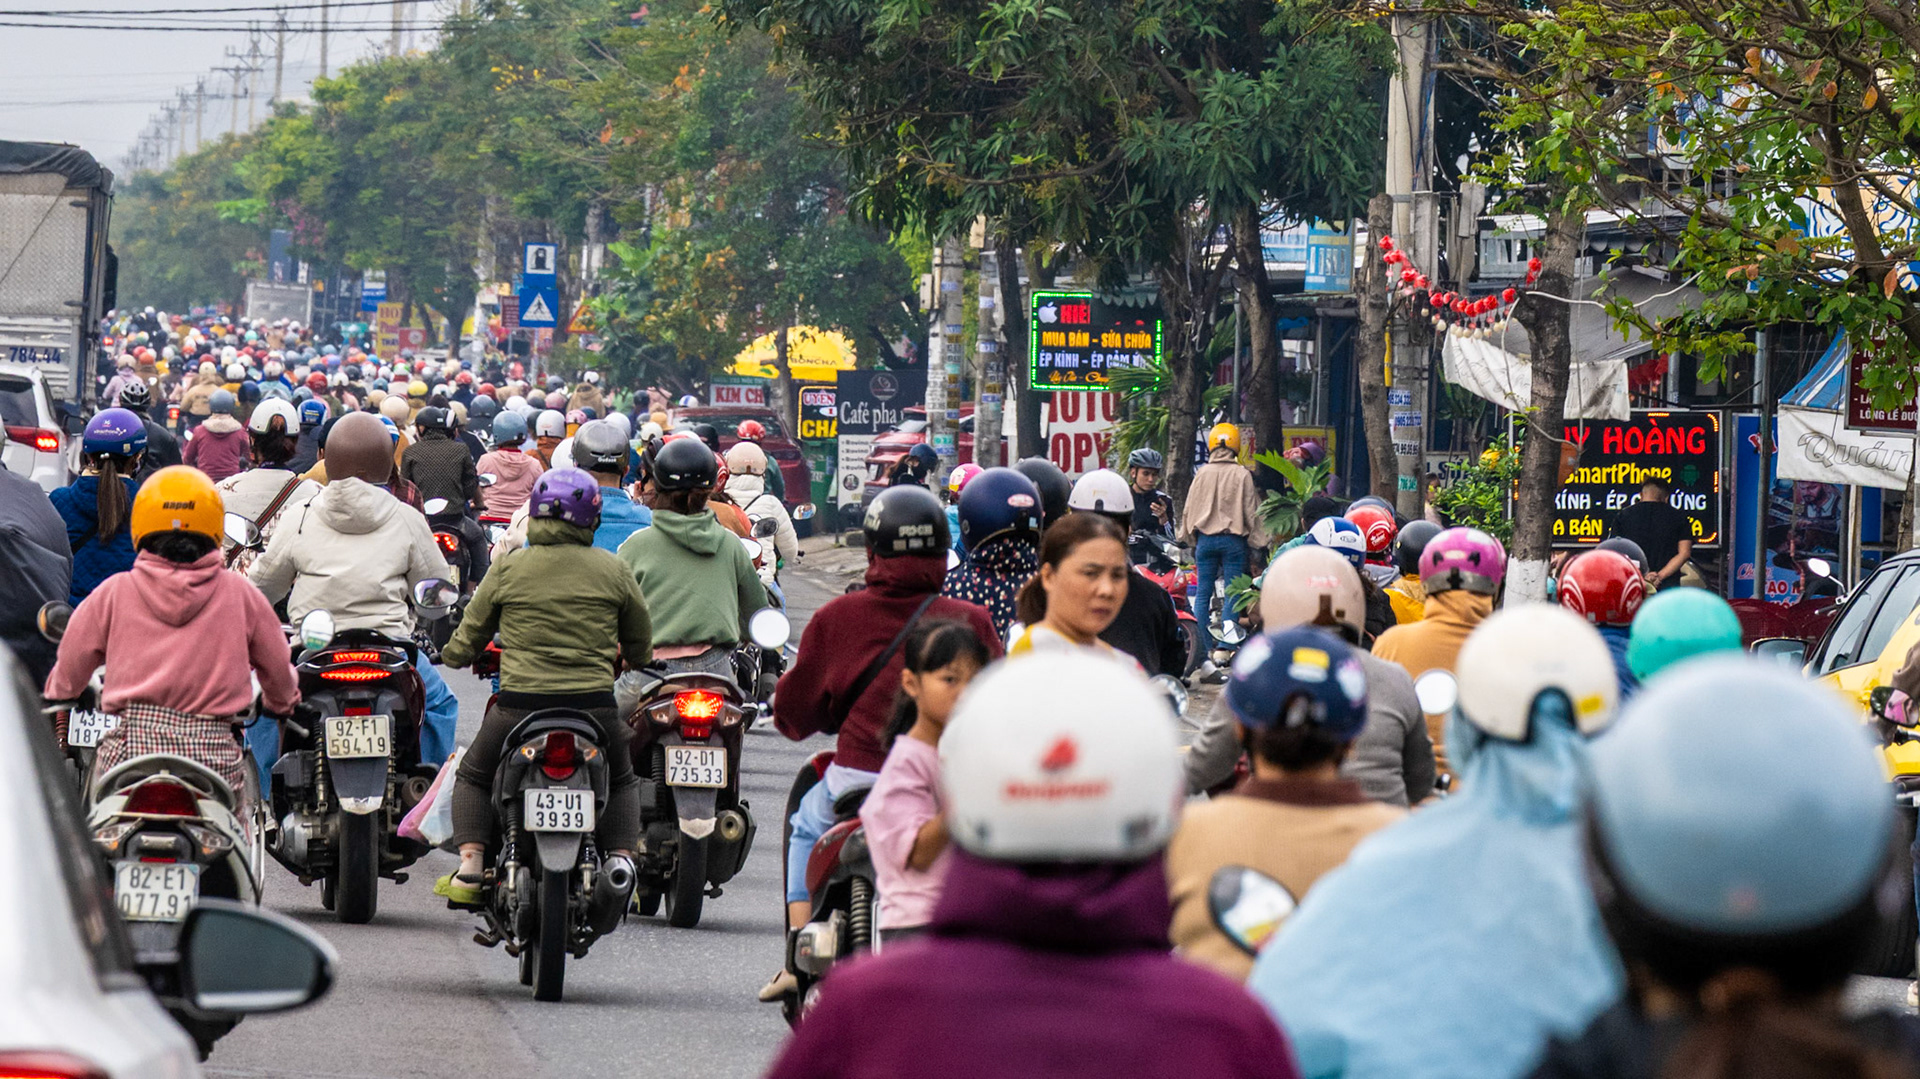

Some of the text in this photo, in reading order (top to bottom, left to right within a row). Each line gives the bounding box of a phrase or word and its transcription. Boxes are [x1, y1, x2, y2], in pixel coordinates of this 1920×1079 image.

[1042, 331, 1066, 347] MUA
[1068, 330, 1090, 347] BÁN
[1101, 329, 1122, 348] SỬA
[1124, 331, 1152, 348] CHỮA
[1040, 350, 1053, 367] ÉP
[1055, 350, 1080, 368] KÍNH
[1091, 351, 1104, 368] ÉP
[714, 386, 764, 404] KIM CH
[802, 388, 836, 406] UYÊN
[840, 401, 898, 432] Café pha
[1564, 418, 1706, 455] Y HOÀNG
[1051, 432, 1113, 474] OPY
[1797, 432, 1914, 472] Quán
[162, 501, 195, 511] napoli
[1605, 489, 1628, 510] ÉP
[1569, 514, 1603, 536] BÁN
[1766, 580, 1788, 598] ẠO
[75, 728, 101, 743] 187
[336, 719, 377, 737] 92-F1
[331, 736, 386, 756] 594.19
[674, 750, 715, 767] 92-D1
[670, 766, 723, 784] 735.33
[536, 793, 582, 810] 43-U1
[536, 811, 584, 828] 3939
[129, 867, 185, 890] 82-E1
